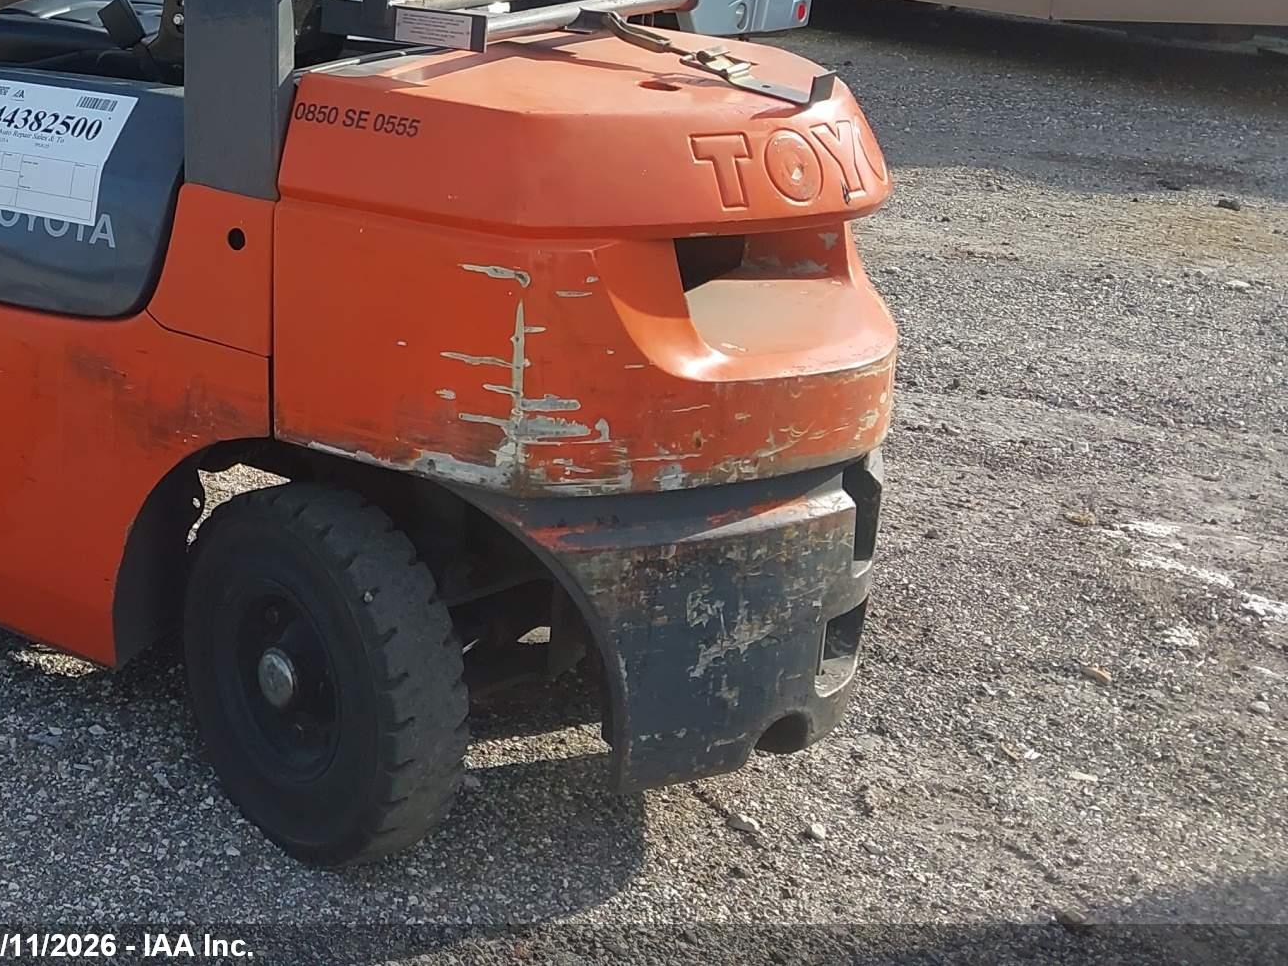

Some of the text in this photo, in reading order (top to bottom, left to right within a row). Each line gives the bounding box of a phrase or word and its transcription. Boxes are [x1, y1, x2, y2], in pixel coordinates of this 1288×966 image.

[294, 102, 421, 137] 0850 SE 0555
[12, 130, 31, 139] Repair
[32, 132, 47, 141] Sales
